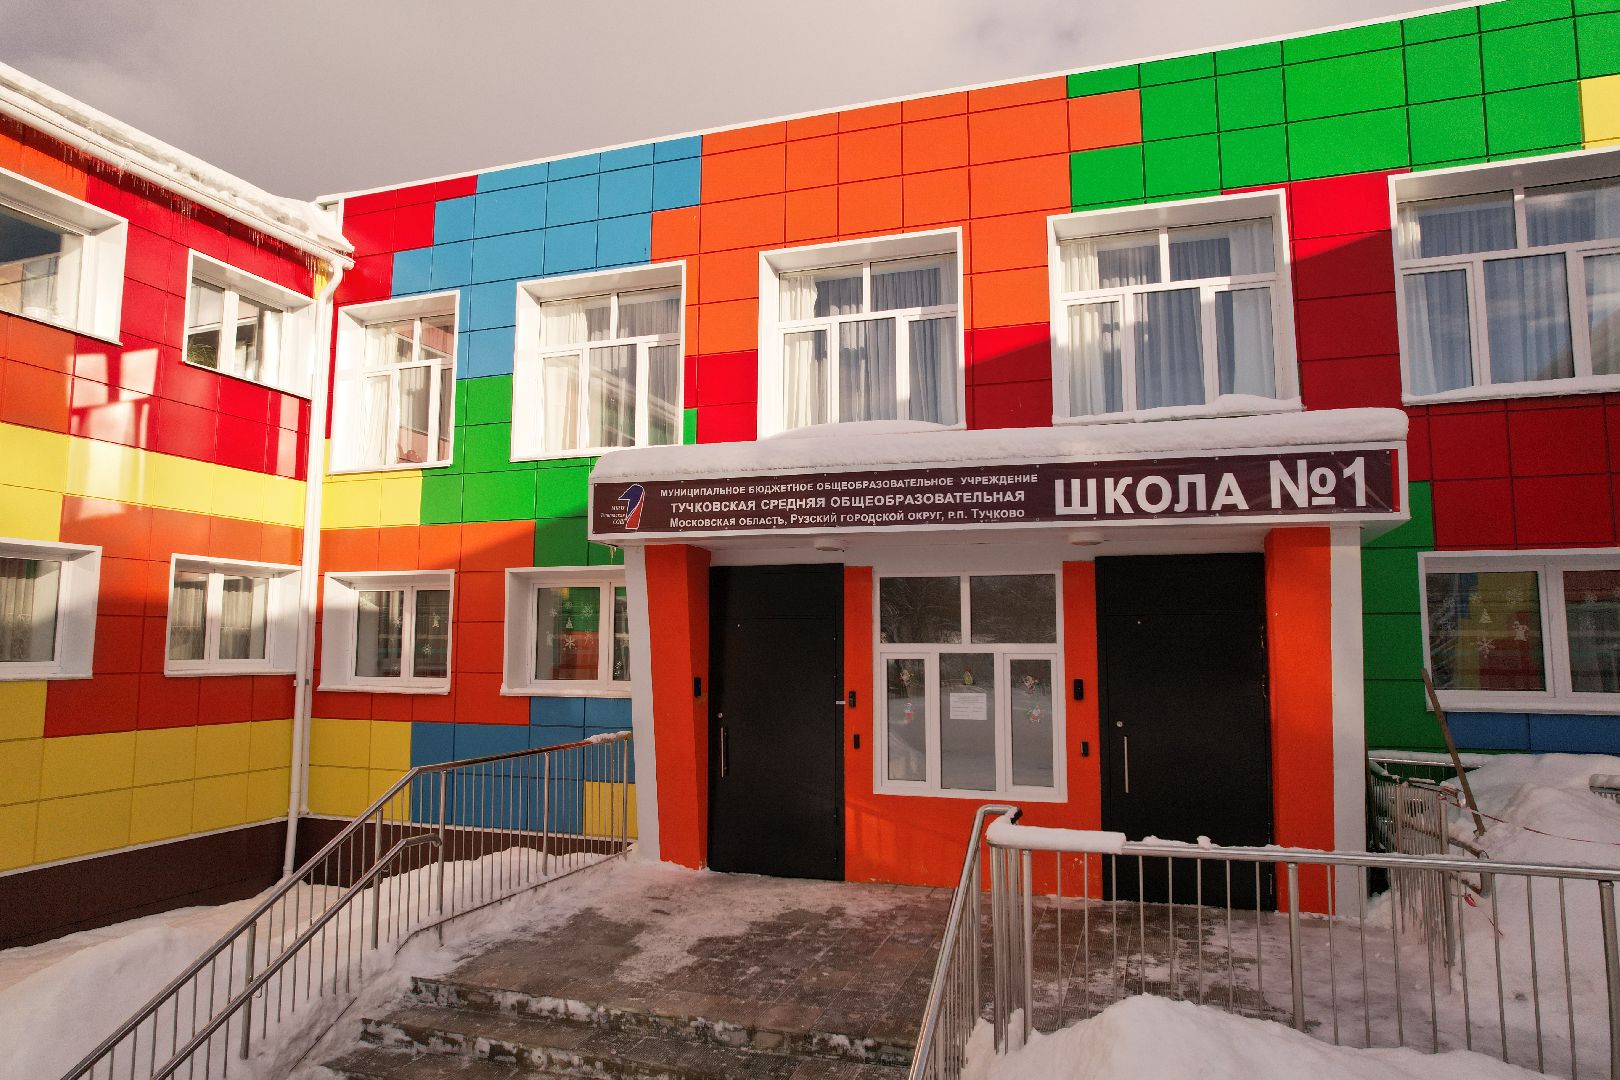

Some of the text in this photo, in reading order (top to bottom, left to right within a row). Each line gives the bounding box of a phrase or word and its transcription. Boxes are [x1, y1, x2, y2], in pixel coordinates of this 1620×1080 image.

[660, 474, 1038, 498] МУНИЦИПАЛЬНОЕ БЮДЖЕТНОЕ ОБЩЕОБРАЗОВАТЕЛЬНОЕ УЧРЕЖДЕНИЕ
[1054, 456, 1367, 516] ШКОЛА №1
[671, 490, 1025, 514] ТУЧКОВСКАЯ СРЕДНЯЯ ОБЩЕОБРАЗОВАТЕЛЬНАЯ
